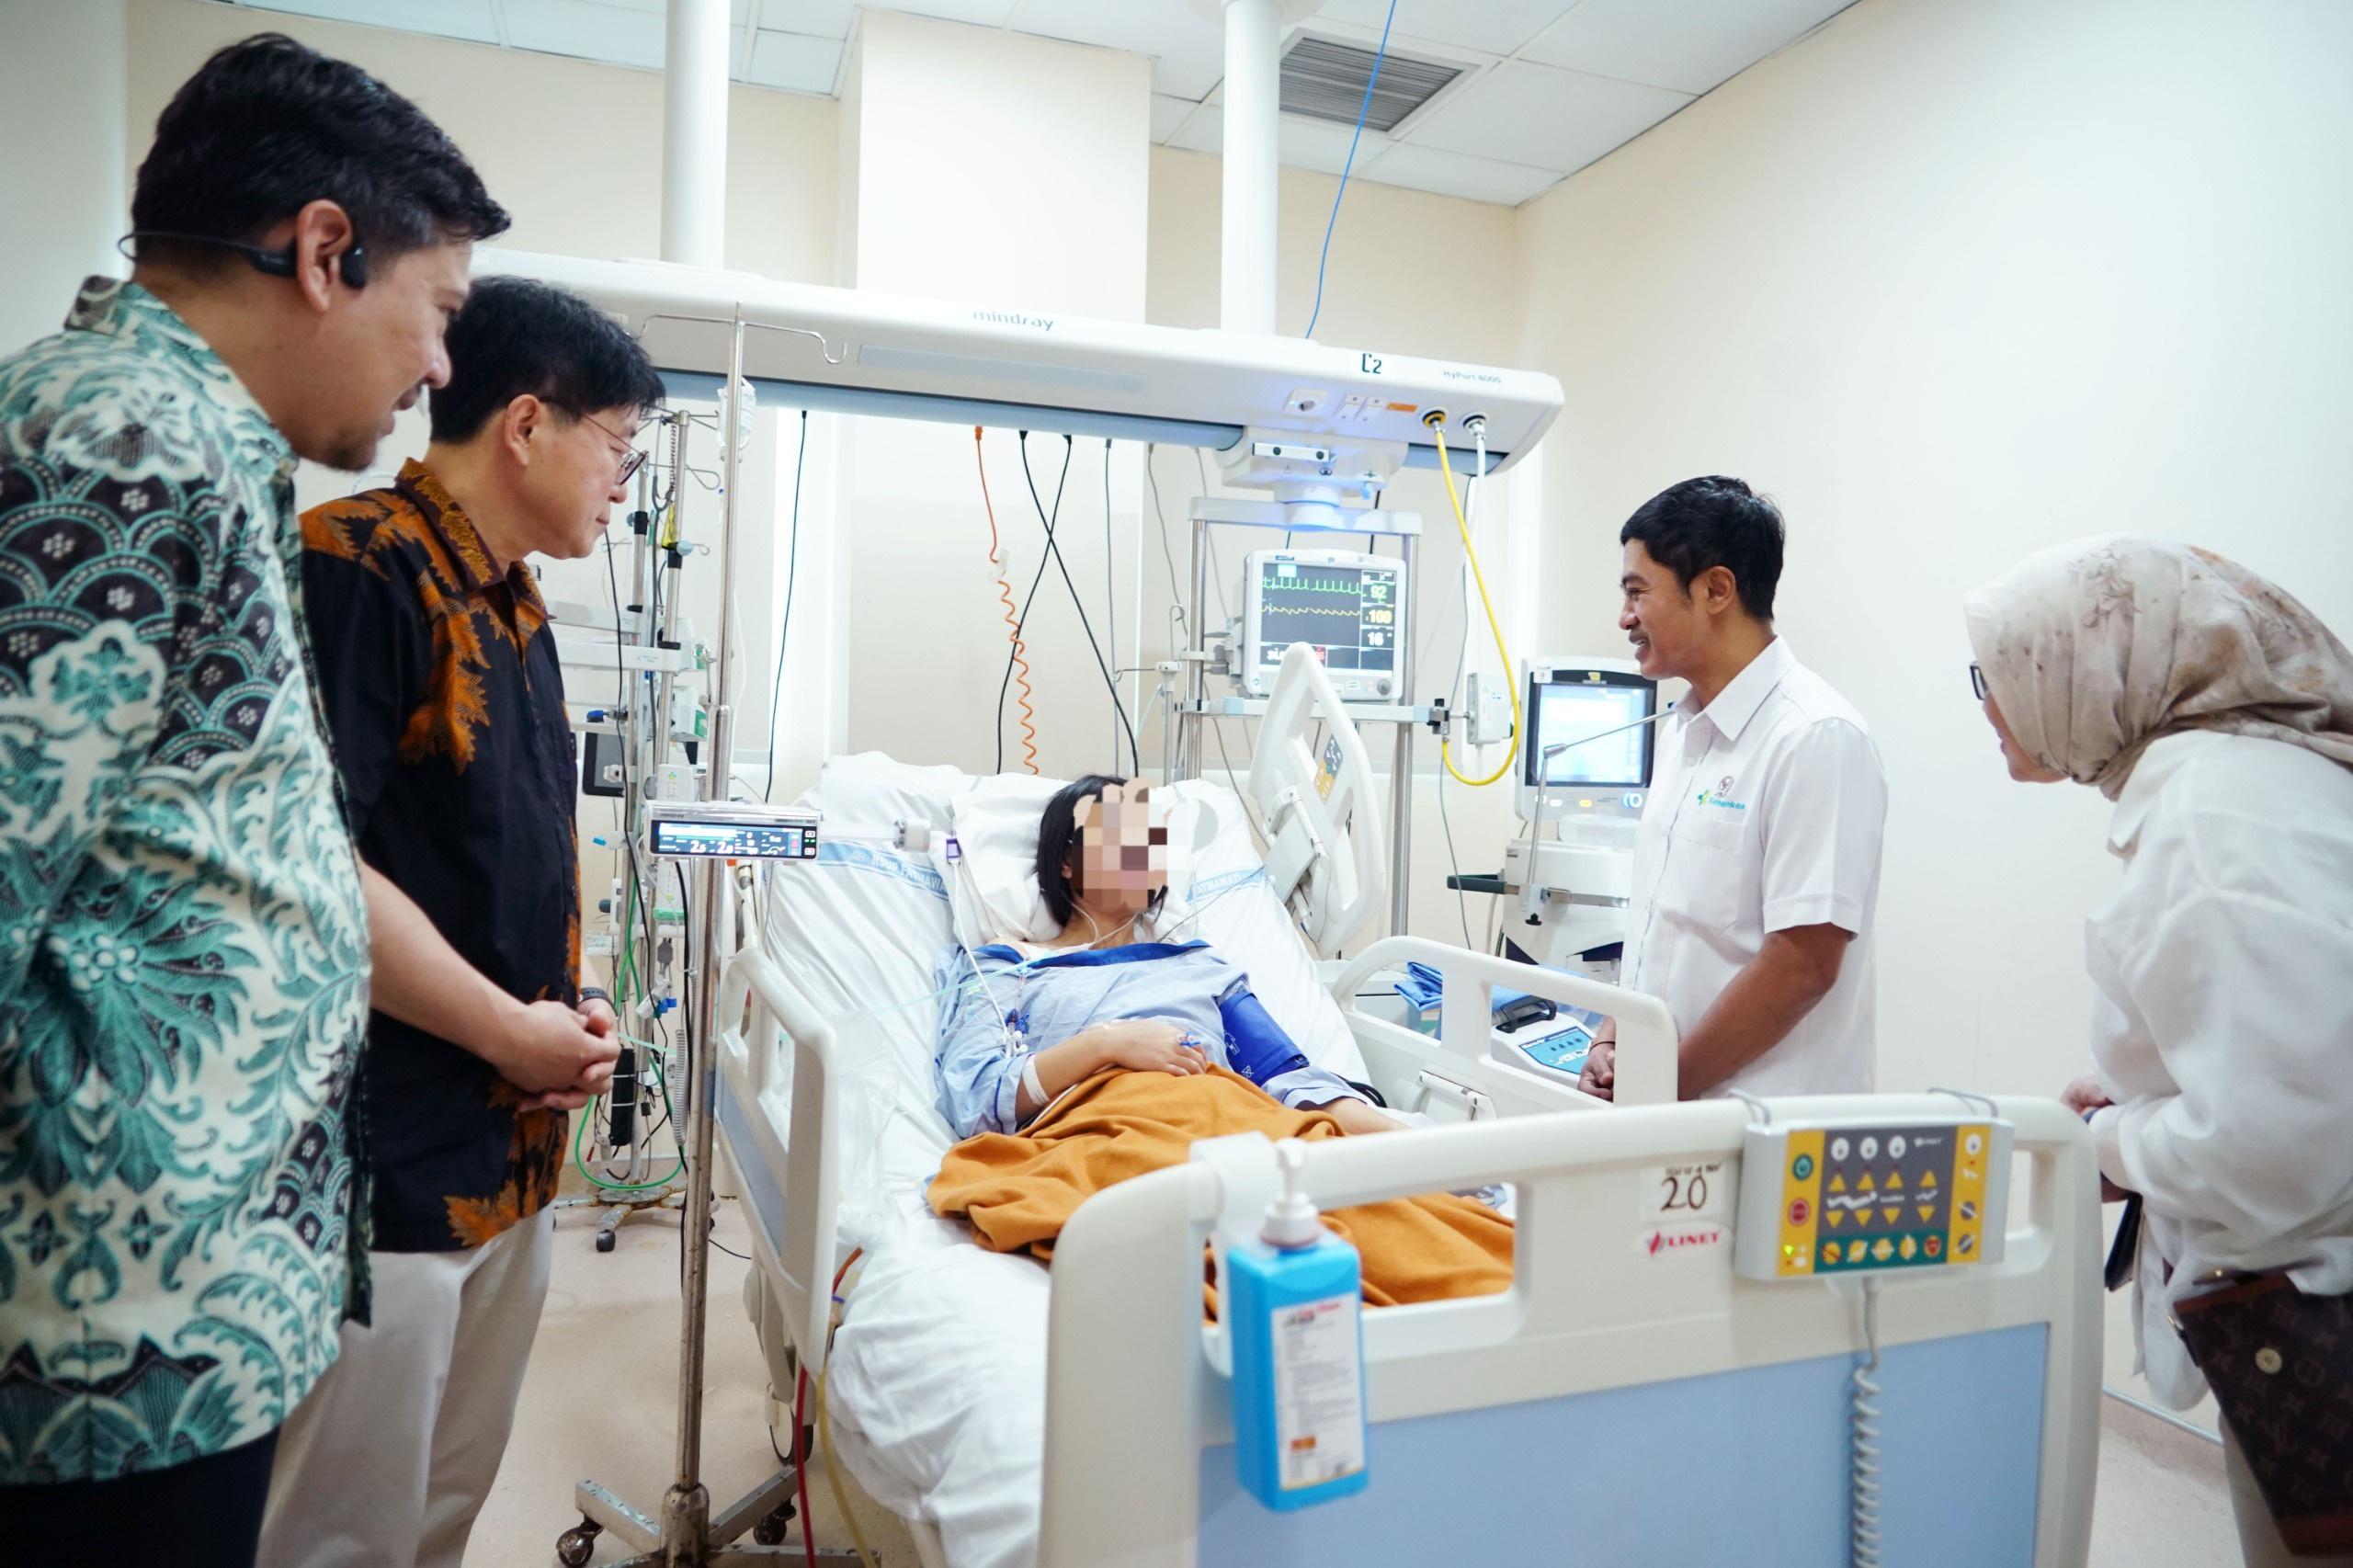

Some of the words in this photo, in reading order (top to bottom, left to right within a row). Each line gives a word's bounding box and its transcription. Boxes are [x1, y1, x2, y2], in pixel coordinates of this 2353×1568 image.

[972, 310, 1054, 332] mindray
[1660, 1175, 1707, 1212] 20
[1667, 1232, 1719, 1247] LINET
